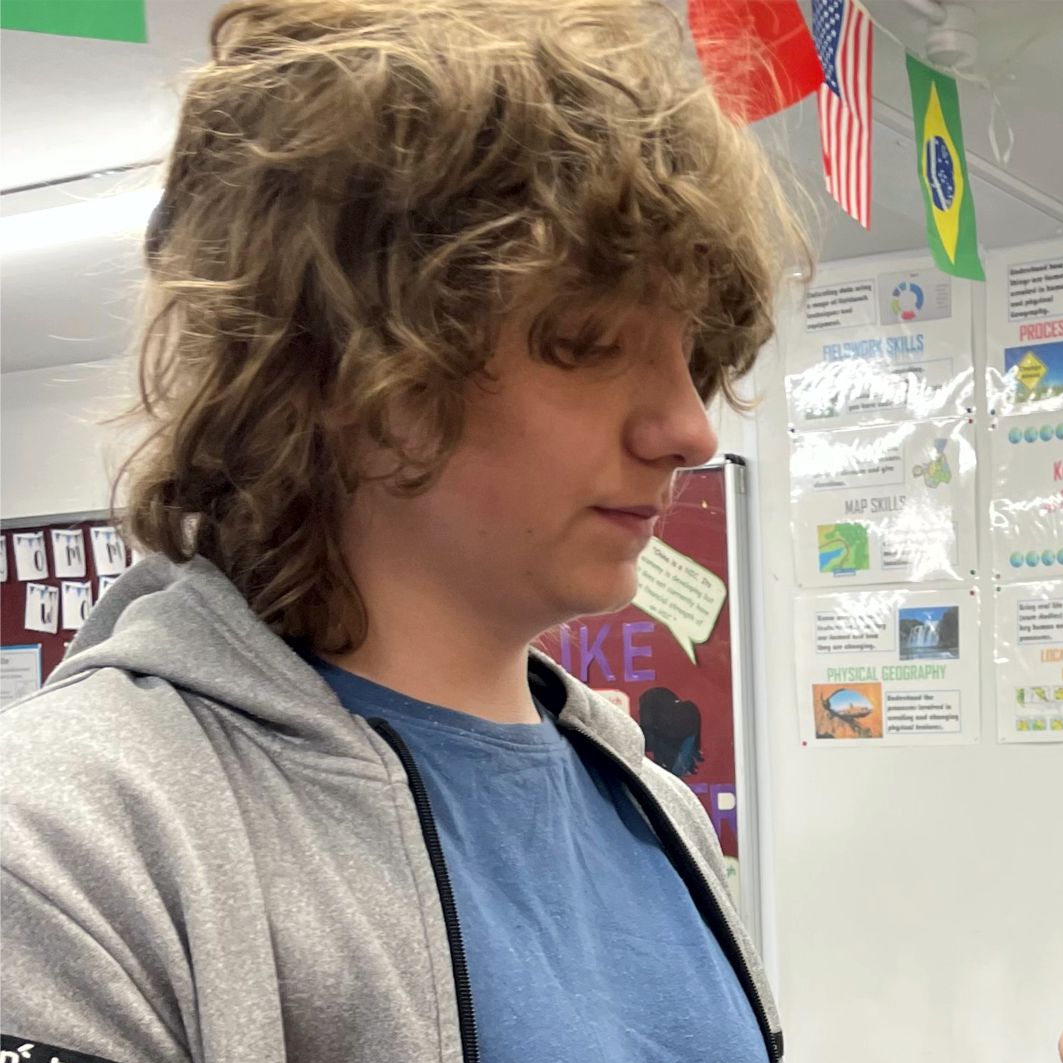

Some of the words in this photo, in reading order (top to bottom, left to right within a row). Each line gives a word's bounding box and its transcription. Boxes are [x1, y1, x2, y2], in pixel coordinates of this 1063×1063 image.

[886, 333, 924, 357] SKILLS
[844, 498, 868, 515] MAP
[826, 666, 879, 682] PHYSICAL
[881, 664, 946, 682] GEOGRAPHY
